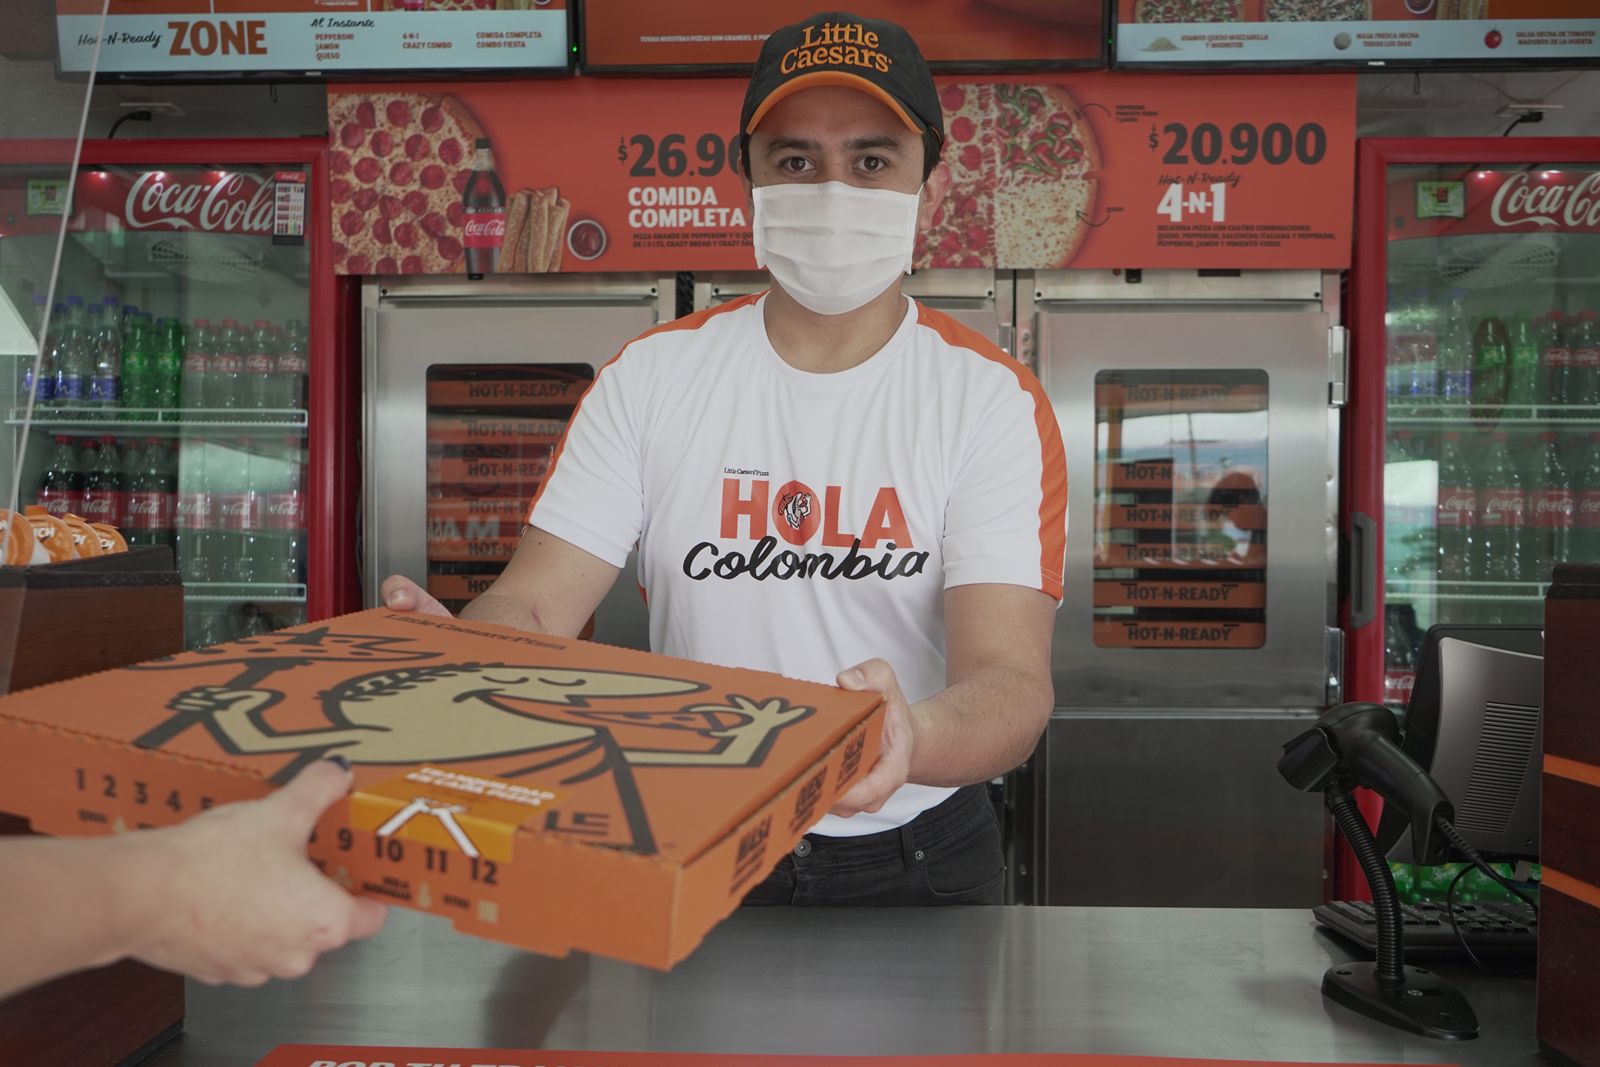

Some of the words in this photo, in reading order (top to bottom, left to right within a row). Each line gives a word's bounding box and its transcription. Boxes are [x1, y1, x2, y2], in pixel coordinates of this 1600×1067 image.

[327, 18, 375, 28] Instante
[168, 19, 268, 56] ZONE
[402, 41, 426, 49] CRAZY
[800, 22, 879, 49] Little
[780, 45, 889, 74] Caesars
[1158, 172, 1243, 189] Hot-N-Ready
[628, 187, 718, 206] COMIDA
[1157, 182, 1226, 222] 4-N-1
[628, 208, 746, 228] COMPLETA
[469, 383, 569, 398] HOT-N-READY
[1127, 386, 1230, 401] HOT-N-READY
[720, 478, 914, 549] HOLA
[682, 535, 931, 581] Colombia
[1127, 585, 1232, 601] HOT-N-READY
[435, 622, 508, 640] Caesars
[1127, 625, 1233, 641] HOT-N-READY
[76, 768, 86, 791] 1
[103, 774, 117, 798] 2
[134, 781, 148, 805] 3
[166, 789, 182, 812] 4
[337, 828, 353, 852] 9
[375, 835, 403, 863] 10
[426, 846, 448, 873] 11
[471, 857, 498, 885] 12
